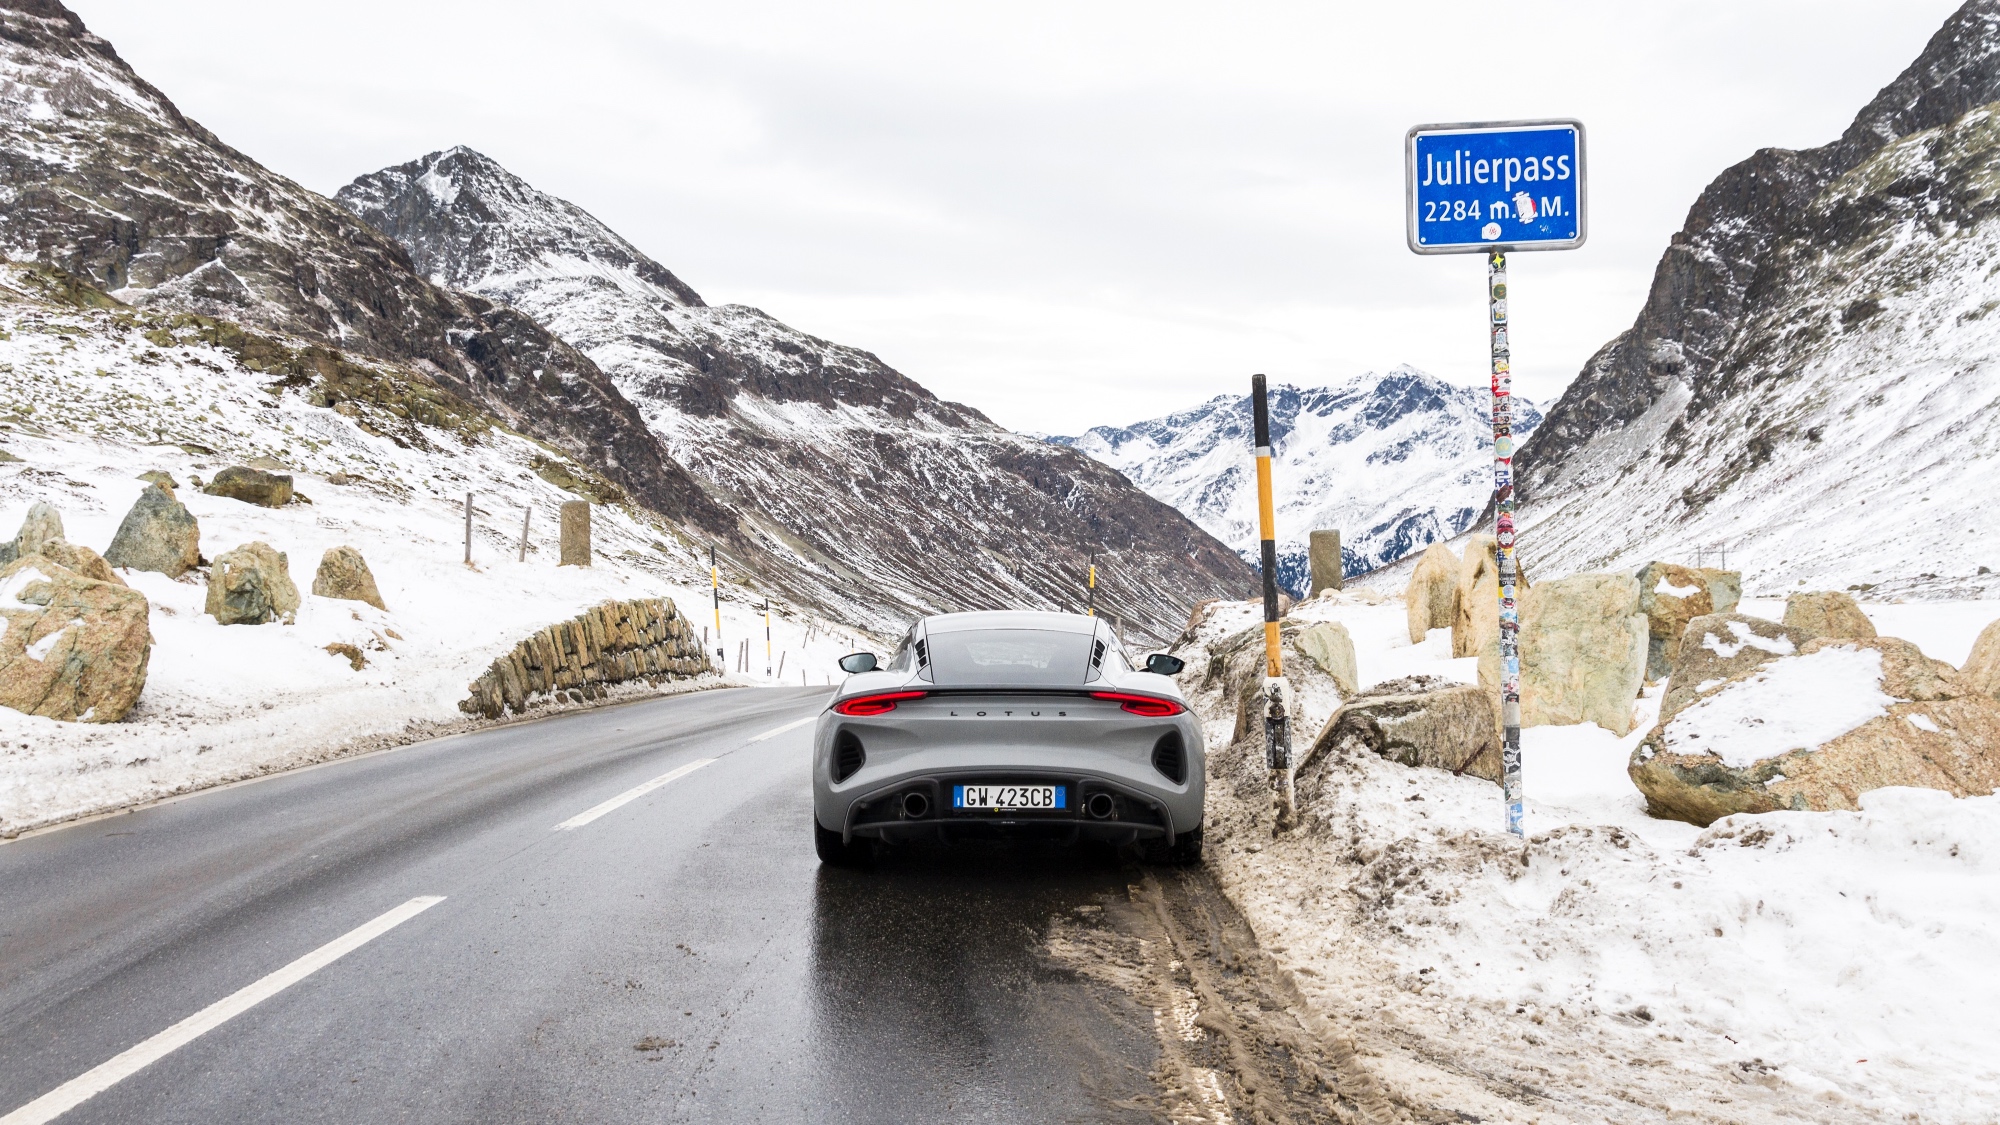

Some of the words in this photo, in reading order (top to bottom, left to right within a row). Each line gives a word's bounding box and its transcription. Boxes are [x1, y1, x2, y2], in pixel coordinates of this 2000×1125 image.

[1422, 149, 1571, 192] Julierpass
[1424, 199, 1482, 222] 2284
[966, 787, 988, 807] GW
[995, 788, 1053, 807] 423CB
